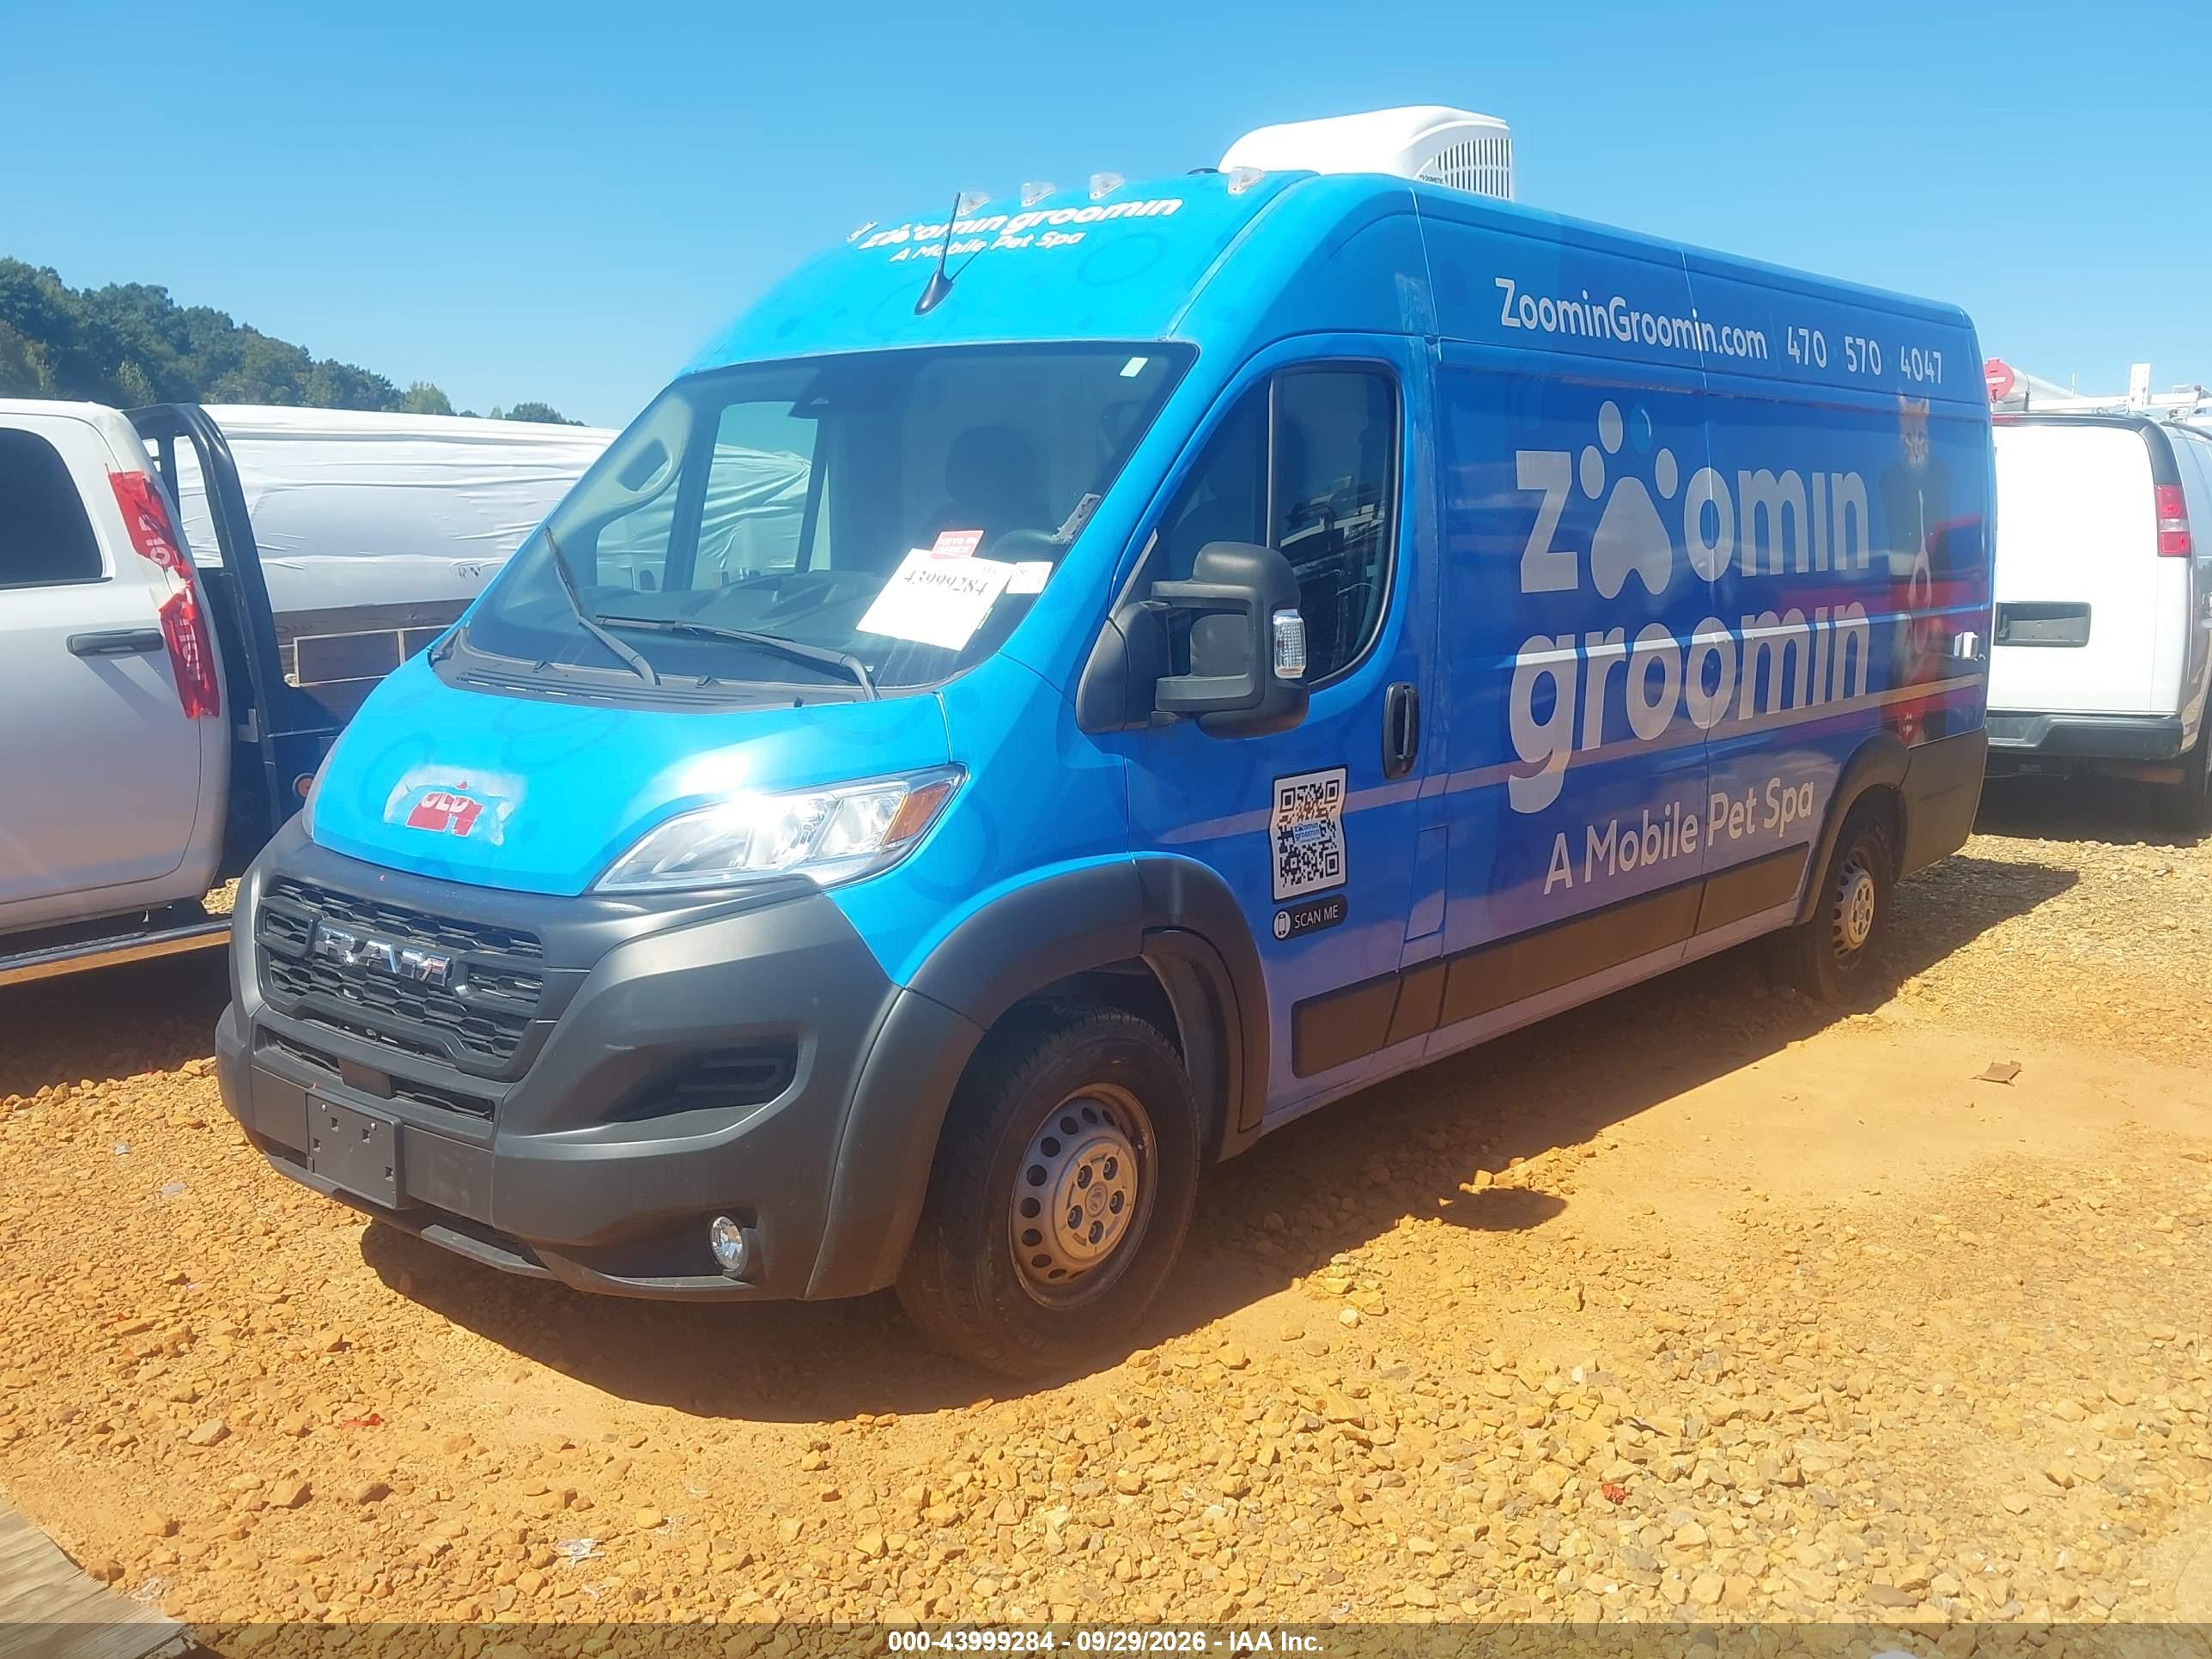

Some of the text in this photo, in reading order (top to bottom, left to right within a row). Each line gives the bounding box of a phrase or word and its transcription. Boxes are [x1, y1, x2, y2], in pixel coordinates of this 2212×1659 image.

[889, 247, 910, 262] A
[989, 234, 1035, 251] Pet
[1034, 231, 1086, 249] Spa
[1000, 198, 1183, 235] groomin
[1494, 276, 1942, 385] ZoominGroomin.com 470 570 4047
[1508, 601, 1870, 814] groomin
[1544, 776, 1814, 895] A Mobile Pet Spa
[1294, 904, 1340, 929] SCAN ME
[315, 926, 452, 987] RAM
